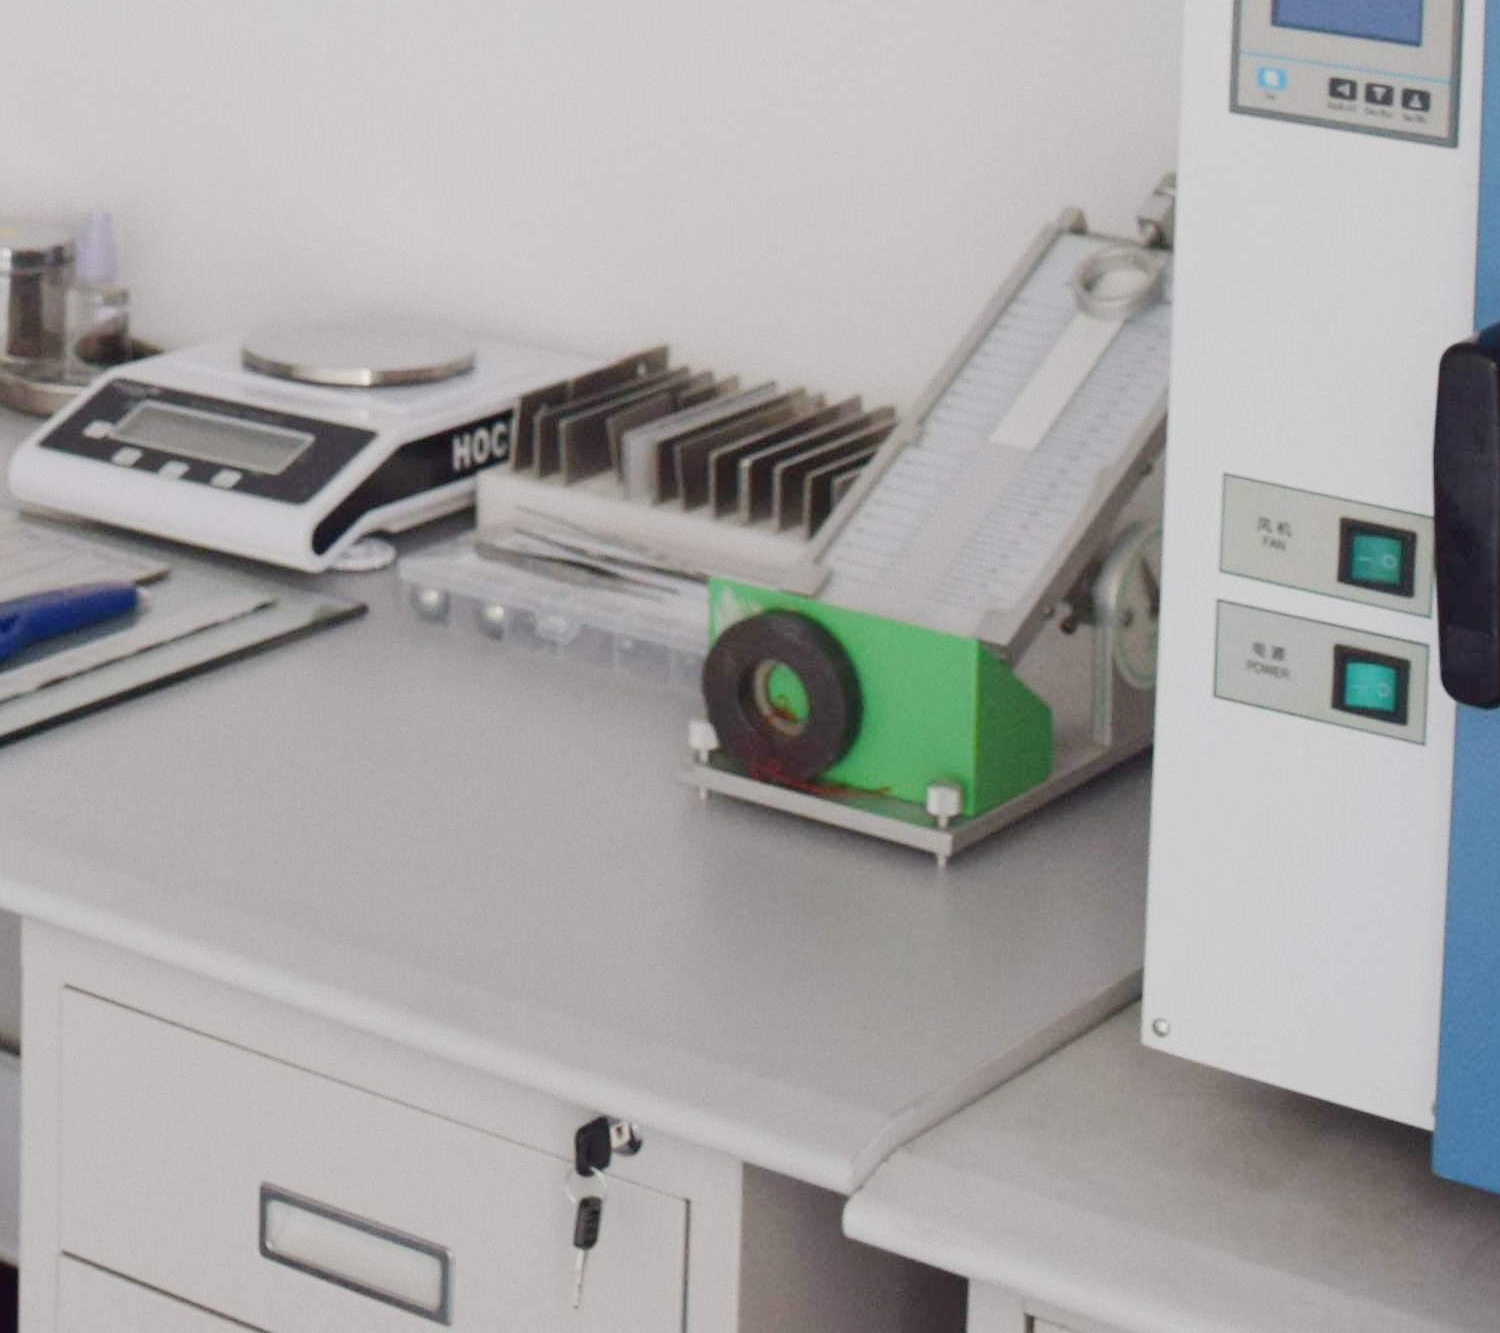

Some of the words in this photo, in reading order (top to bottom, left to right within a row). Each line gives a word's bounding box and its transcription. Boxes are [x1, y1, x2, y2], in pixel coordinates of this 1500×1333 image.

[1257, 516, 1293, 538] 风机
[1261, 538, 1287, 552] FAN
[1252, 641, 1286, 663] 电源
[1245, 661, 1290, 680] POWER
